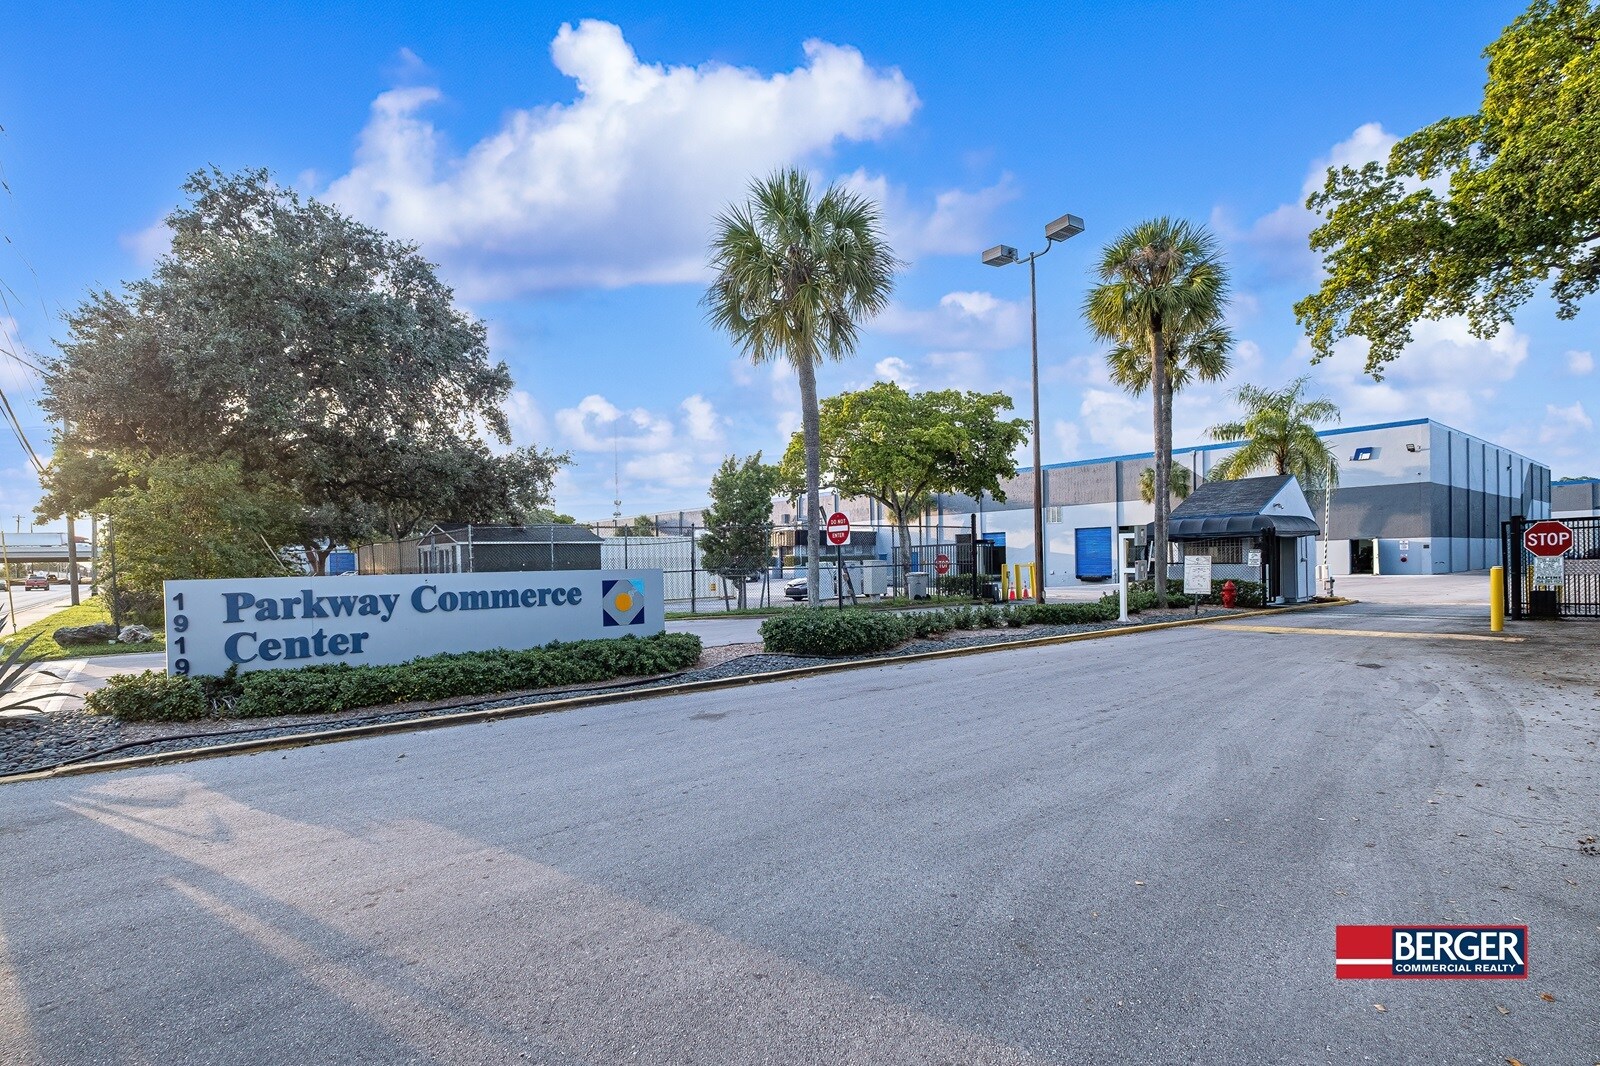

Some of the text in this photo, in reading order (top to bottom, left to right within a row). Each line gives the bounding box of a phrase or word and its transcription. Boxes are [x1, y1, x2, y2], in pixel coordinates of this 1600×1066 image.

[1527, 532, 1570, 547] STOP
[221, 585, 583, 623] Parkway Commerce
[172, 592, 190, 676] 1919
[224, 628, 370, 664] Center
